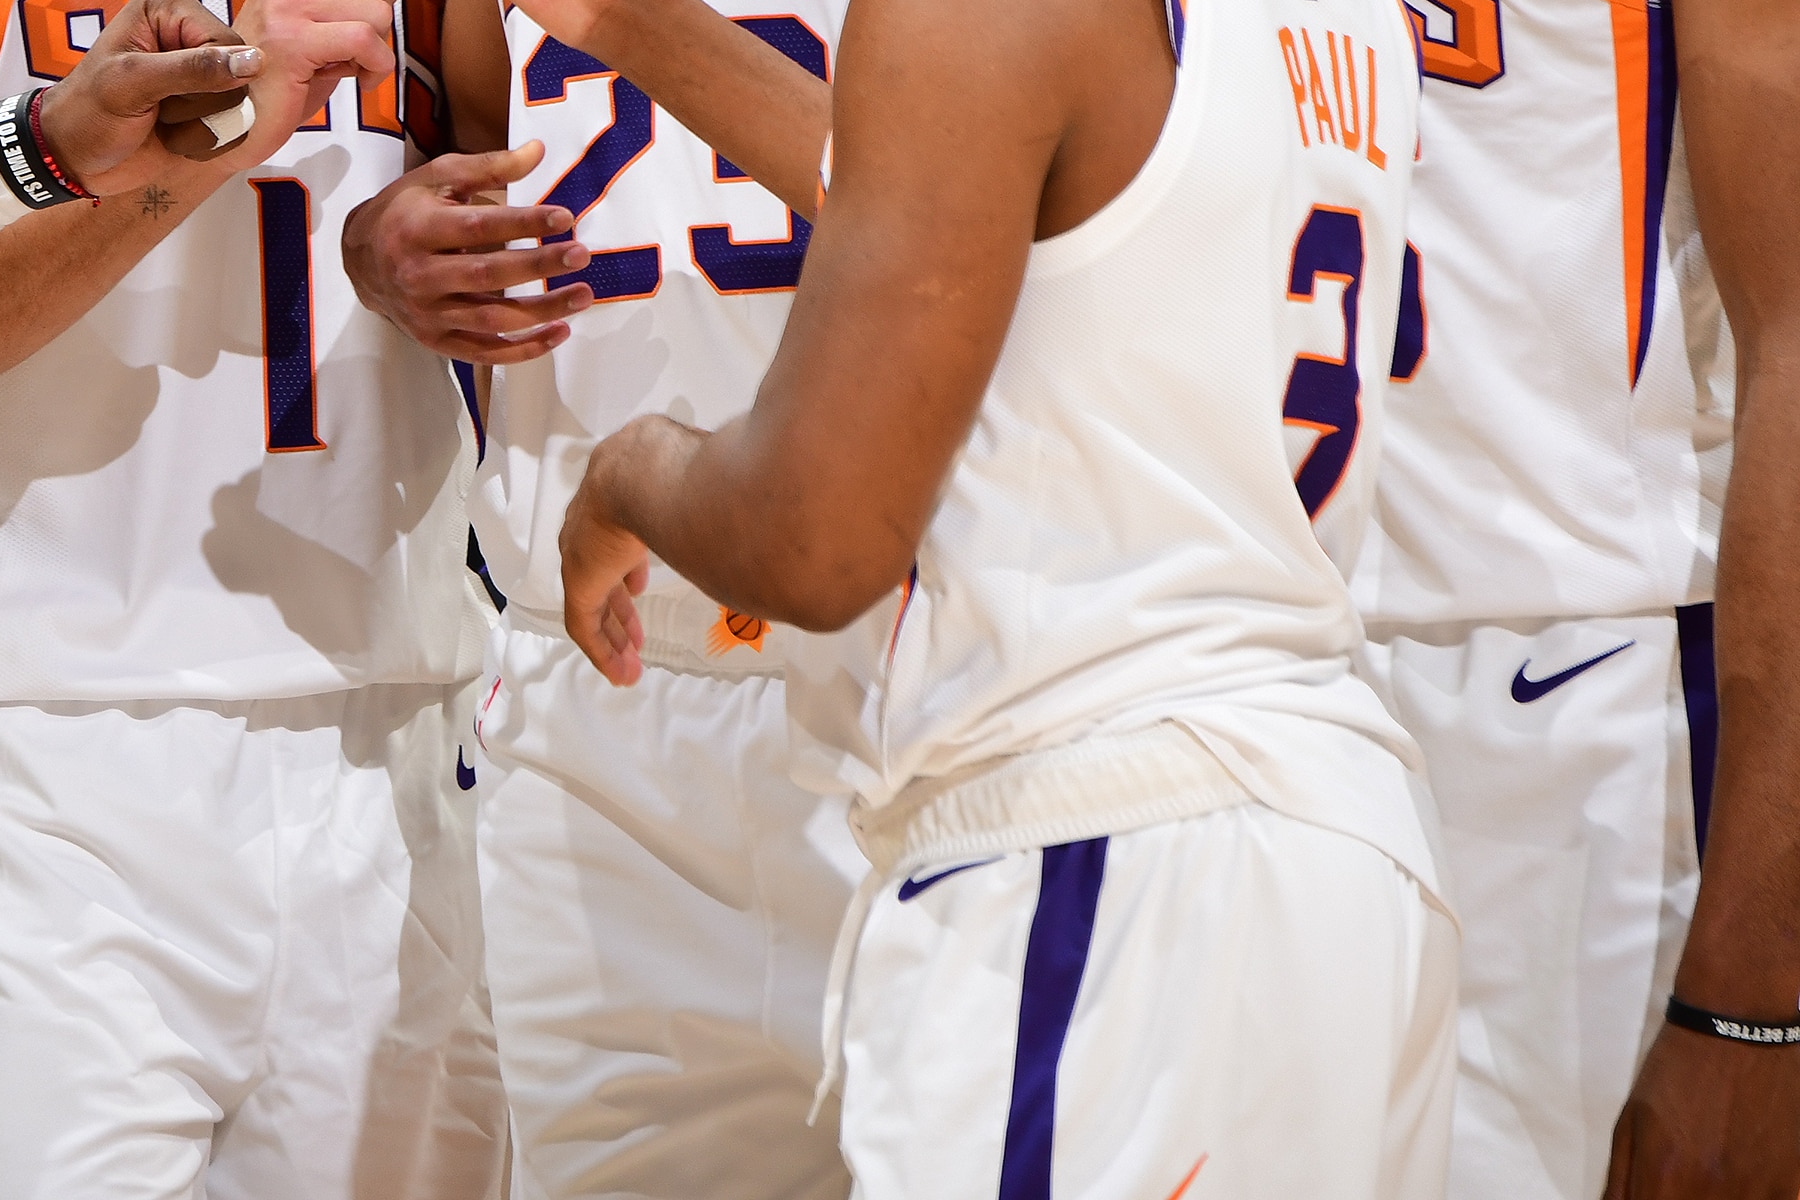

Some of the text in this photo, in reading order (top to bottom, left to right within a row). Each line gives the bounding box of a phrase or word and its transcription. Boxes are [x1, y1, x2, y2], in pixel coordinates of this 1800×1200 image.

[3, 145, 36, 185] TIME
[1278, 25, 1387, 171] PAUL
[248, 176, 327, 454] 1
[1282, 203, 1368, 524] 3
